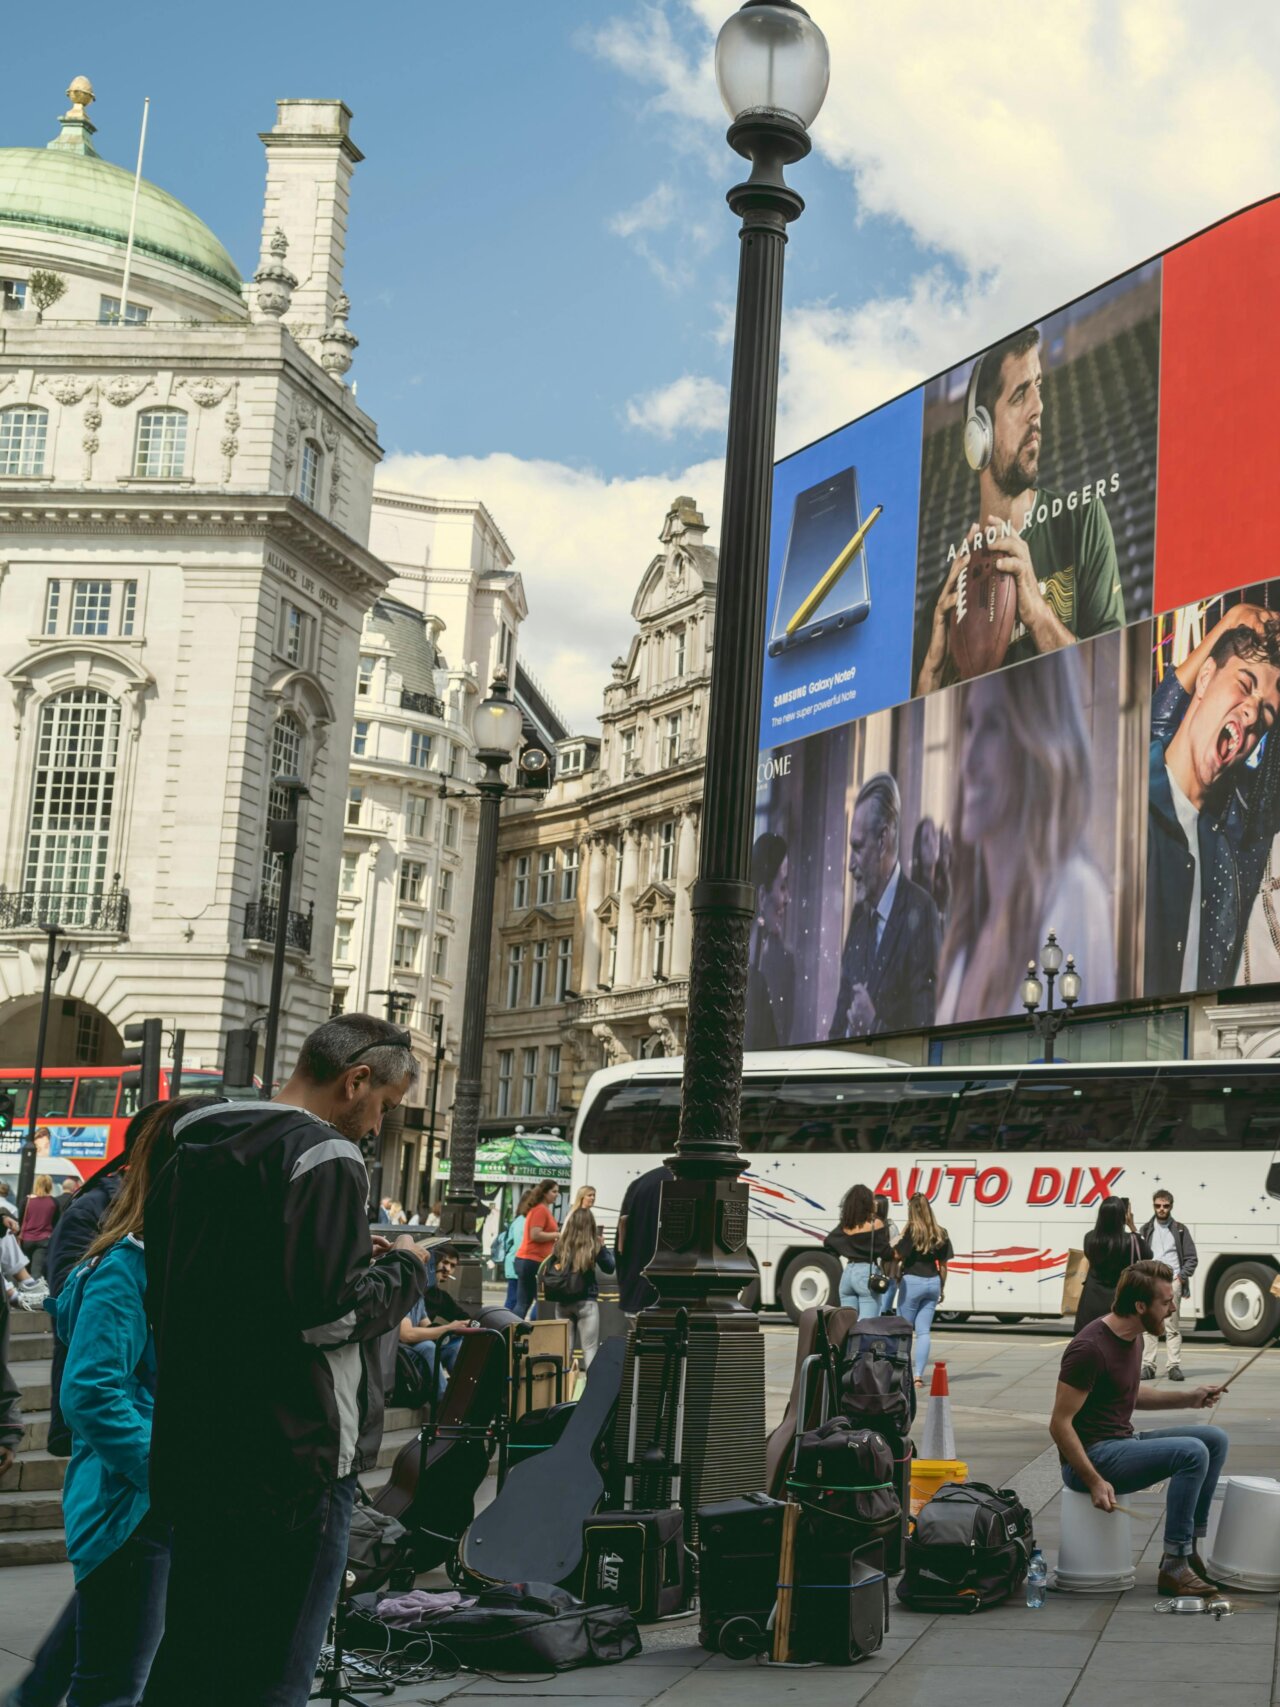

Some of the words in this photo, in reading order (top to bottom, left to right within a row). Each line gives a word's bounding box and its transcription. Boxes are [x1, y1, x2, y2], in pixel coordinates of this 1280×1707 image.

[946, 519, 1013, 562] AARON
[1023, 473, 1121, 529] RODGERS
[267, 551, 298, 582] ALLIANCE
[301, 575, 316, 594] LIFE
[319, 588, 339, 610] OFFICE
[773, 685, 808, 708] SAMSUNG
[808, 675, 835, 694] Galaxy
[834, 666, 857, 685] Note9
[771, 716, 783, 727] The
[782, 713, 796, 725] new
[795, 705, 813, 720] super
[812, 695, 841, 715] powerful
[841, 689, 857, 703] Note
[757, 754, 792, 783] CÔME
[538, 1167, 556, 1177] BEST
[874, 1166, 1012, 1207] AUTO
[1026, 1166, 1126, 1208] DIX
[602, 1552, 624, 1591] AER
